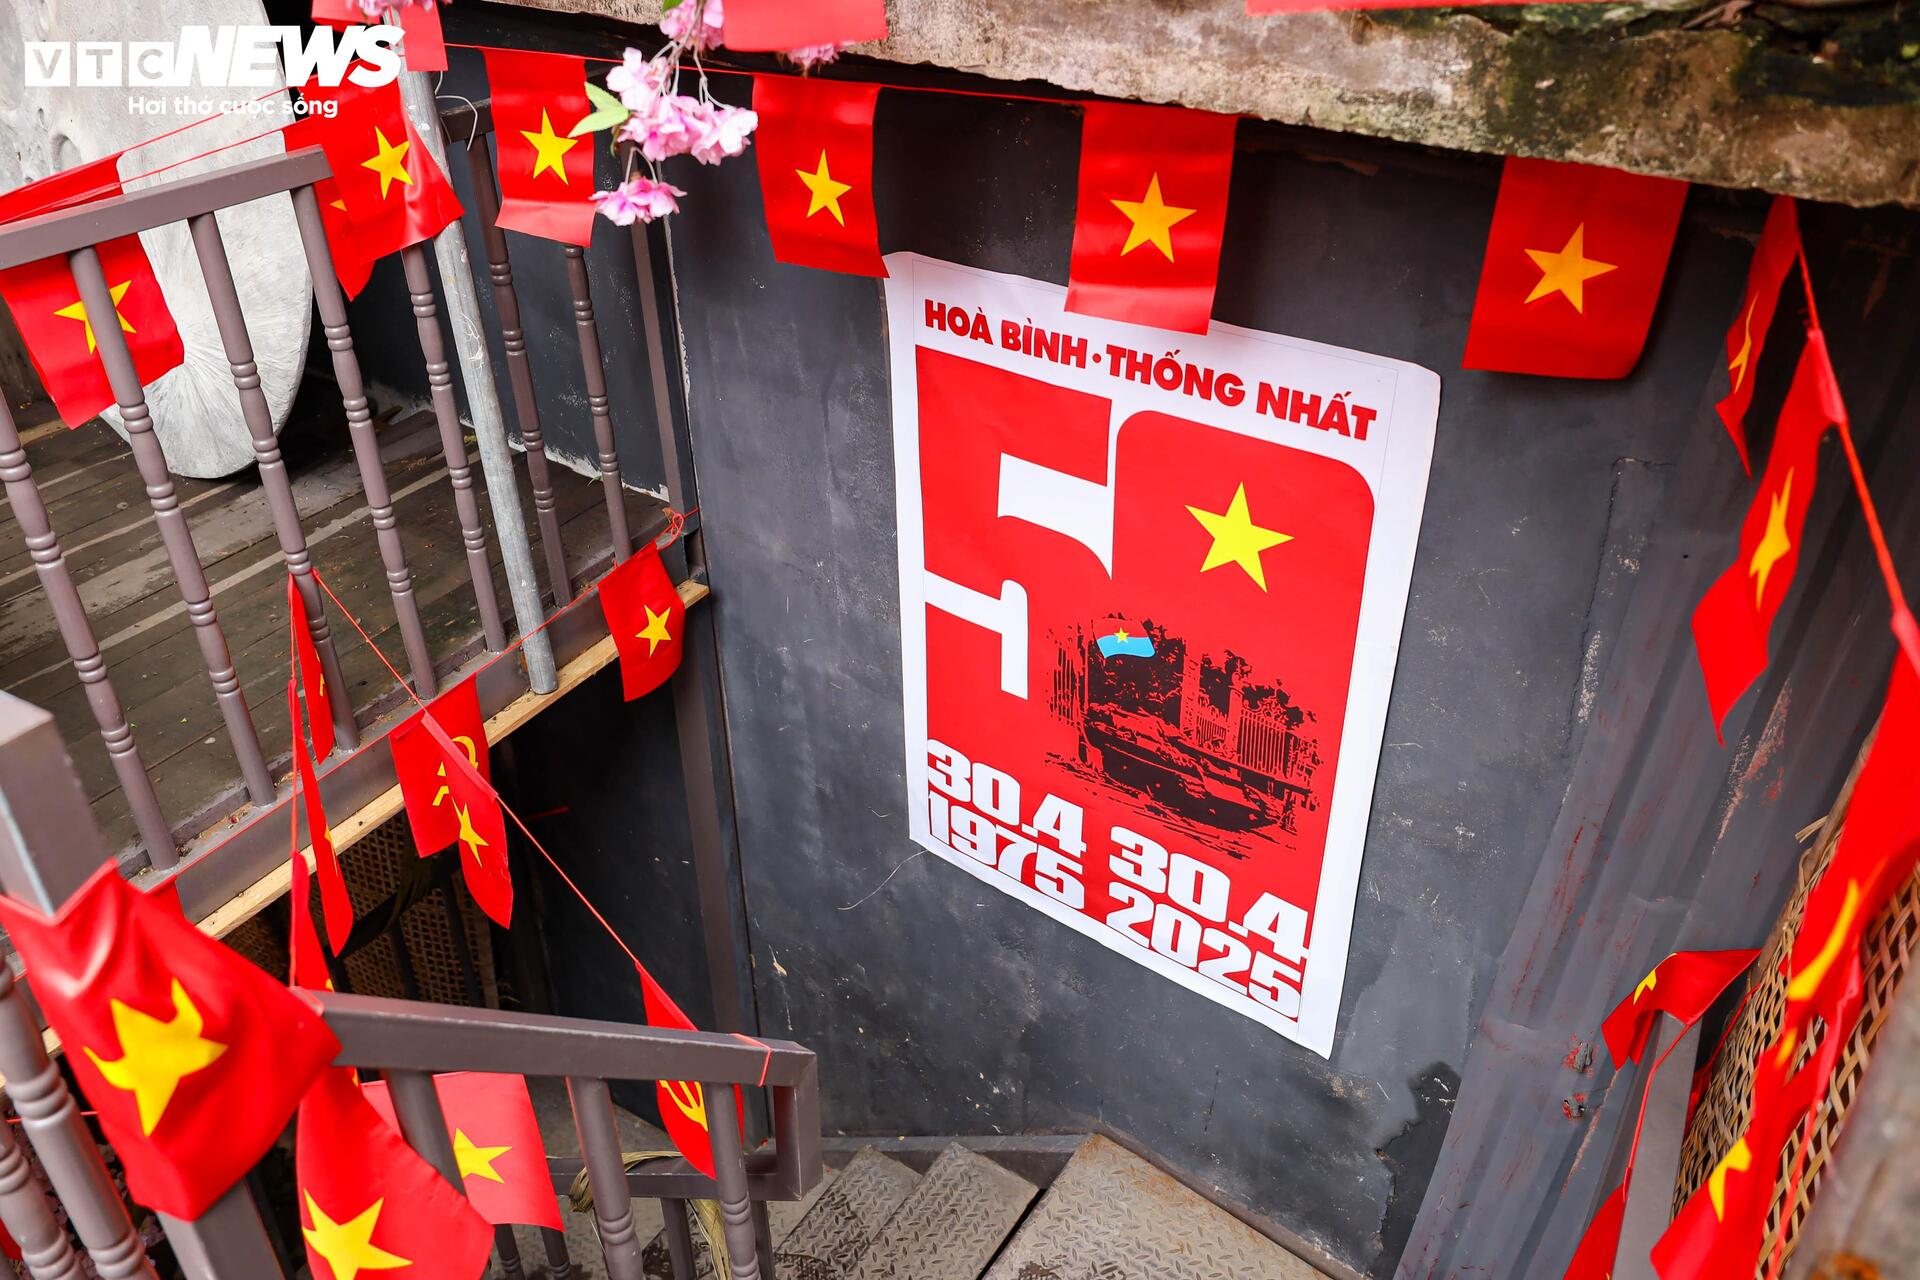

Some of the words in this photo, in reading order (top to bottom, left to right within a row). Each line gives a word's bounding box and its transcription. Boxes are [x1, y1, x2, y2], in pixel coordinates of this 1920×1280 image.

[924, 298, 994, 345] HOÀ
[1001, 318, 1088, 369] BÌNH
[1105, 343, 1246, 407] THỐNG
[1256, 382, 1377, 441] NHẤT
[927, 739, 1087, 858] 30.4
[928, 791, 1085, 910] 1975
[1105, 881, 1302, 1019] 2025
[1108, 825, 1311, 966] 30.4
